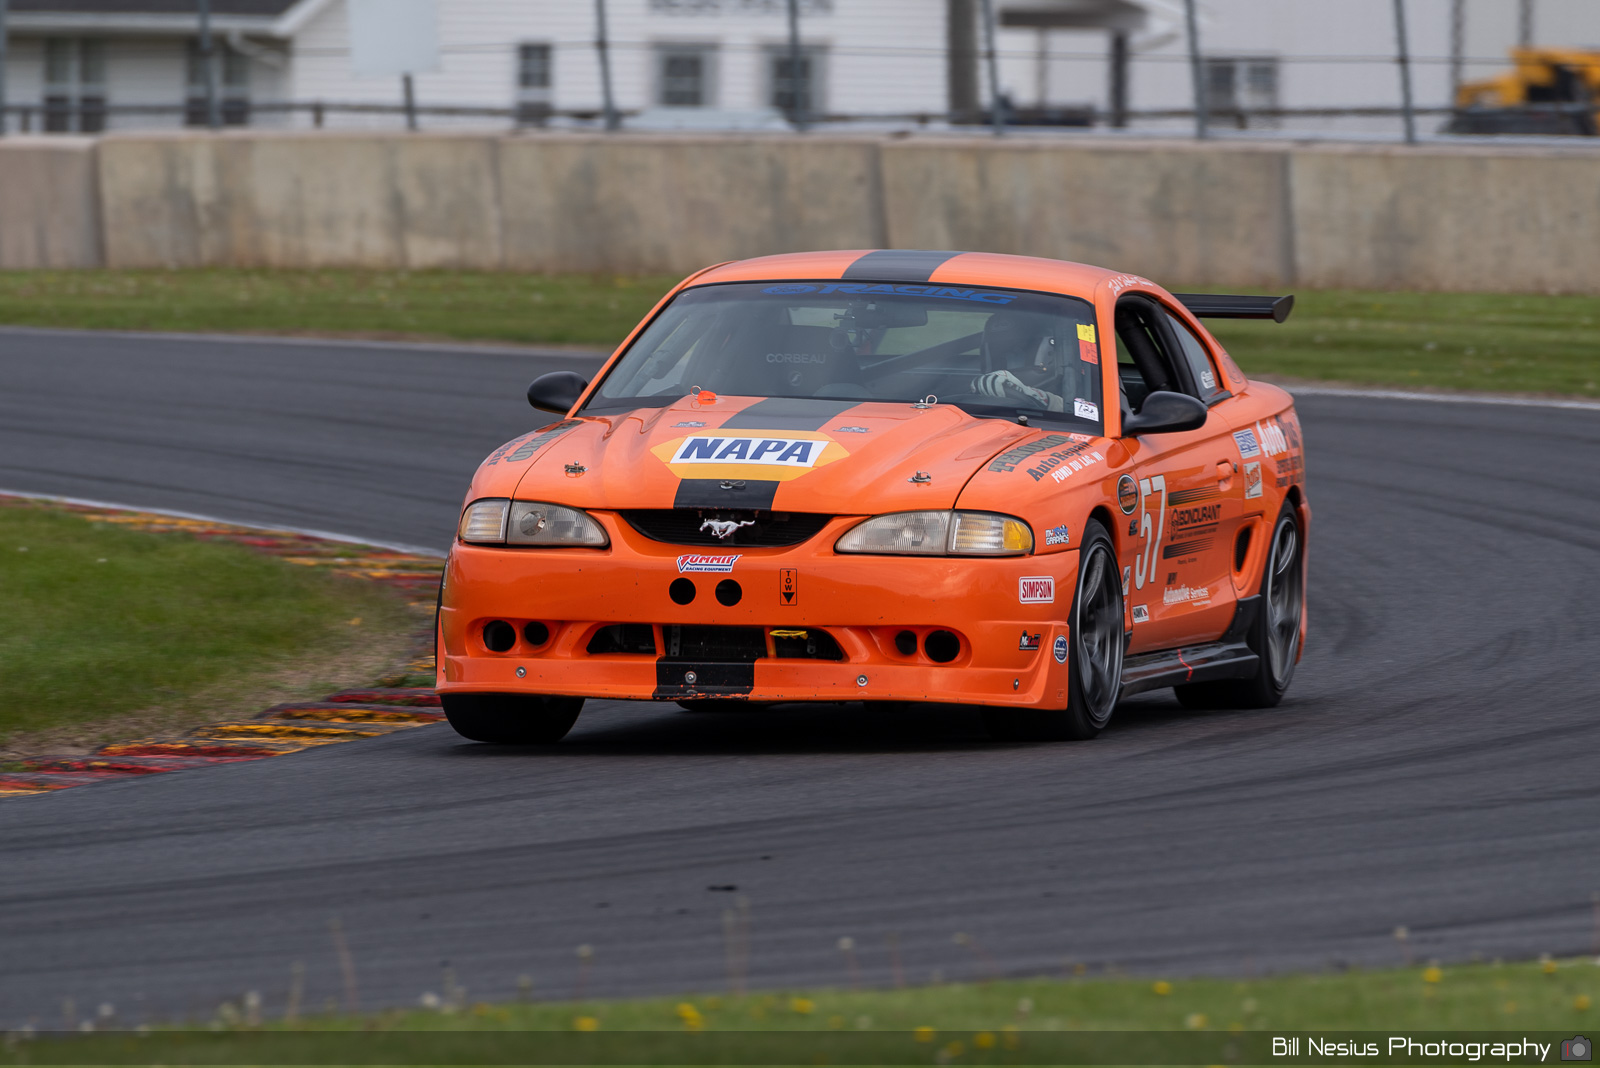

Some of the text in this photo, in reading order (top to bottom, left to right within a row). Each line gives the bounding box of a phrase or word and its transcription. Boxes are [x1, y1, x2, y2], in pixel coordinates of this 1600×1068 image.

[818, 284, 1018, 304] RACING
[766, 353, 826, 364] CORBEAU
[678, 438, 814, 463] NAPA
[1051, 466, 1073, 483] FOND
[1069, 460, 1083, 472] DU
[1180, 504, 1221, 525] BONDURANT
[1135, 474, 1166, 590] 57
[785, 570, 793, 591] TOW
[1022, 581, 1052, 598] SIMPSON
